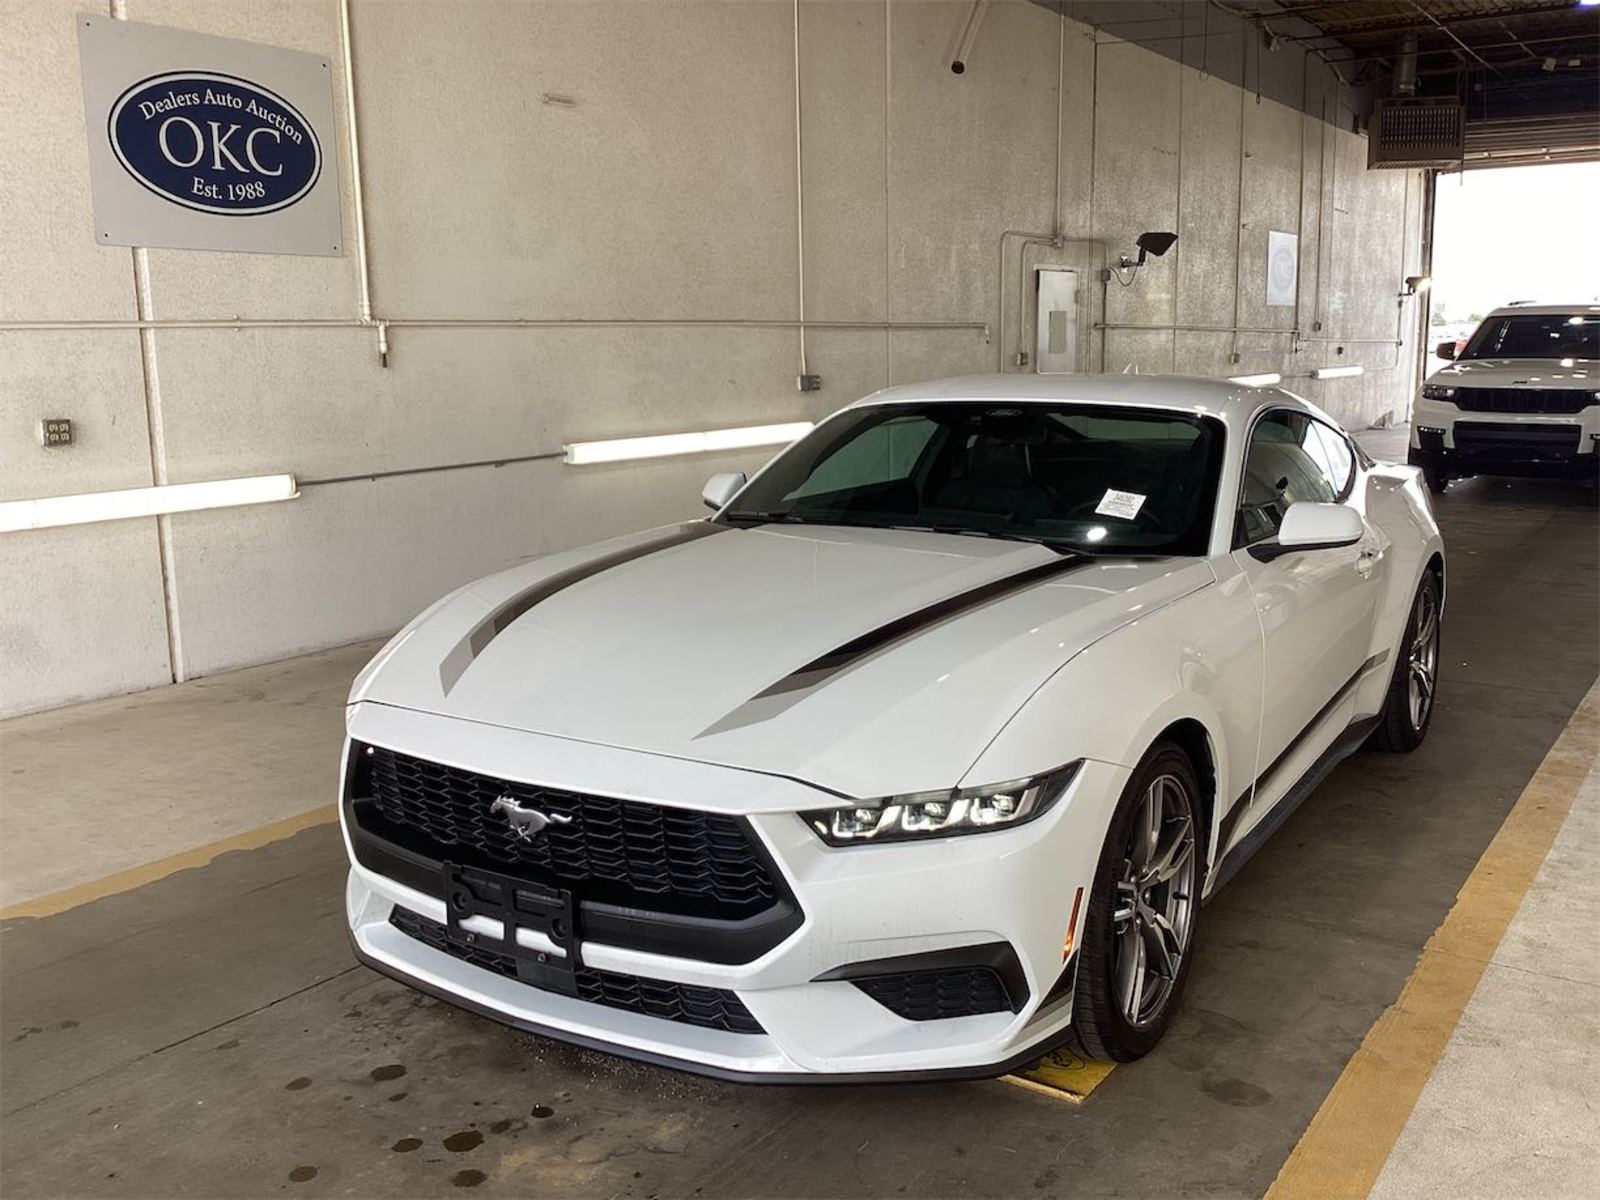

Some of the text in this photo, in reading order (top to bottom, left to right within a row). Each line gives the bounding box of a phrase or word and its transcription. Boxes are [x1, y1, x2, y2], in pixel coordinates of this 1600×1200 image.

[138, 88, 303, 145] Dealers Auto Auction
[158, 116, 283, 177] OKC
[191, 176, 265, 201] Est. 1988
